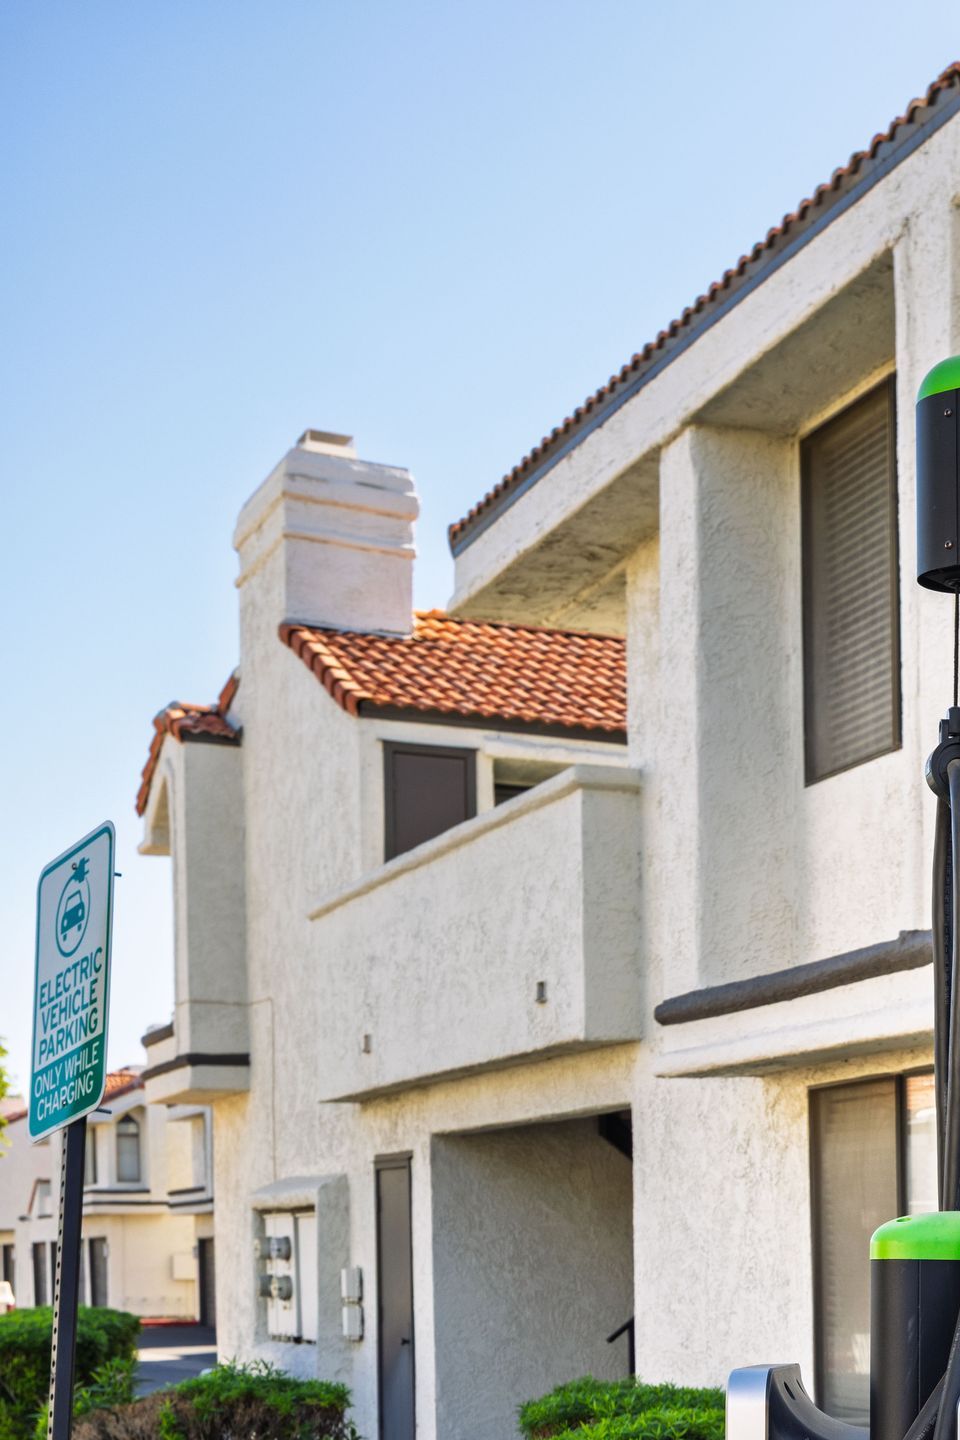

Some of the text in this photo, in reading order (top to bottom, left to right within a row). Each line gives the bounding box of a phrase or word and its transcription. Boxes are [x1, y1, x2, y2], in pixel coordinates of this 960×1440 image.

[39, 946, 103, 1010] ELECTRIC
[41, 977, 98, 1035] VEHICLE
[38, 1007, 98, 1066] PARKING
[34, 1041, 100, 1099] ONLY WHILE
[37, 1070, 94, 1121] CHARGING
